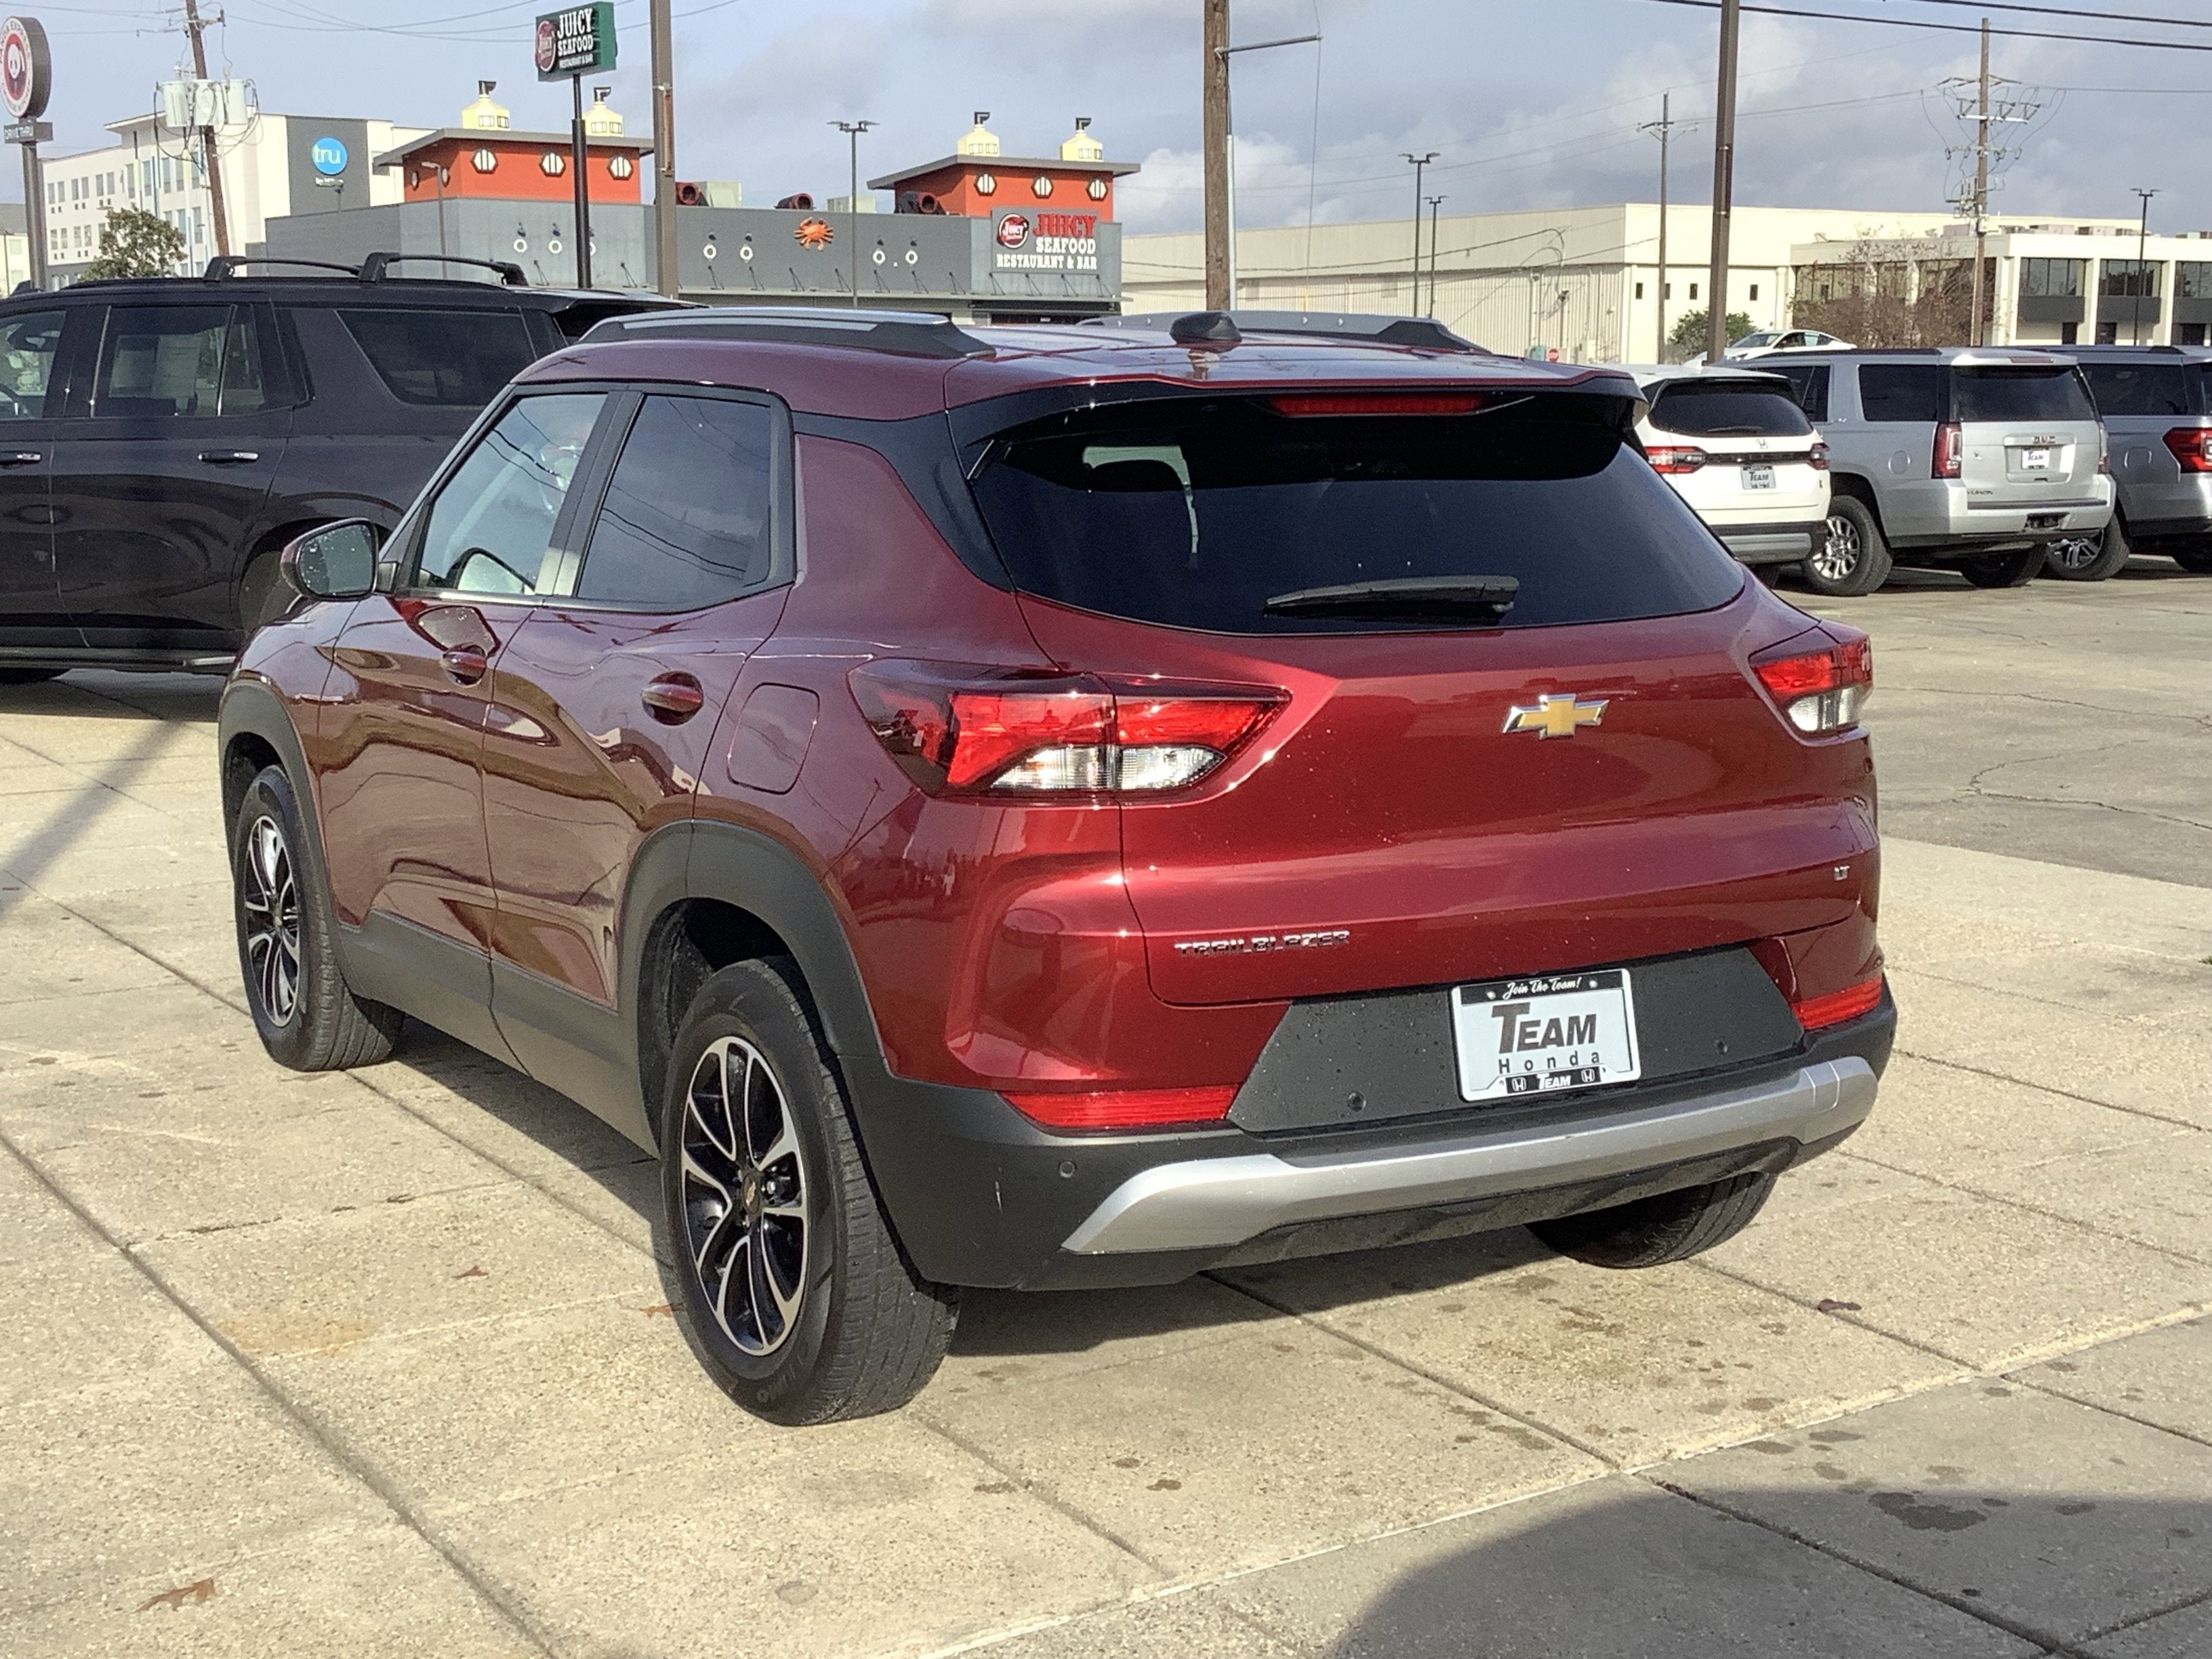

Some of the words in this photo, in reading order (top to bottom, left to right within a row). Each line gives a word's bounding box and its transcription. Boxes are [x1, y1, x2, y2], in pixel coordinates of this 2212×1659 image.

[557, 7, 593, 39] JUICY
[557, 34, 594, 57] SEAFOOD
[312, 144, 341, 165] tru
[1033, 213, 1097, 238] JUICY
[1036, 237, 1096, 254] SEAFOOD
[996, 253, 1064, 268] RESTAURANT
[1066, 255, 1075, 269] &
[1076, 255, 1097, 270] BAR
[1174, 930, 1350, 956] TRAILBLAZER
[1502, 981, 1529, 1000] Join
[1529, 979, 1549, 994] The
[1549, 977, 1582, 991] Team!
[1492, 1002, 1597, 1054] TEAM
[1498, 1050, 1599, 1074] Honda
[1536, 1073, 1572, 1090] TEAM
